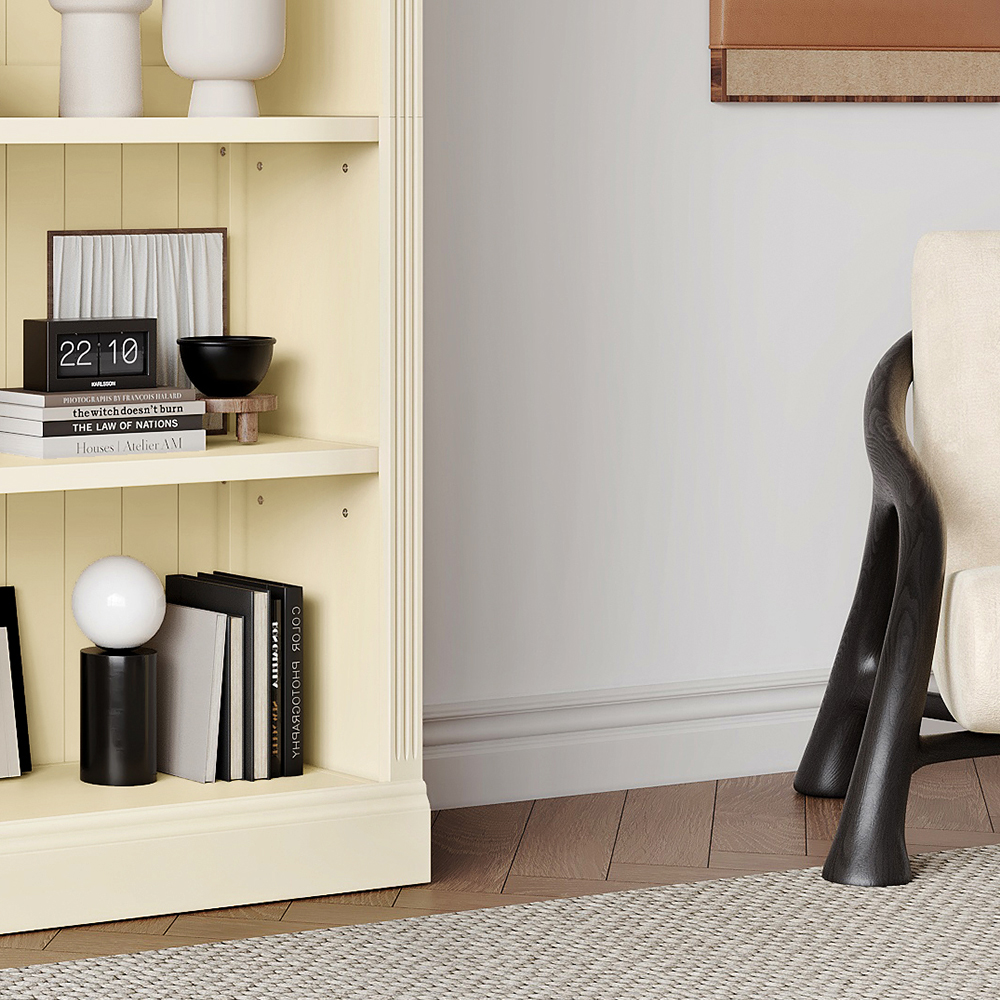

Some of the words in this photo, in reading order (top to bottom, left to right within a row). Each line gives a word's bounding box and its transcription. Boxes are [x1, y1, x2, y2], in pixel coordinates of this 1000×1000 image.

[59, 340, 93, 367] 22
[108, 337, 138, 365] 10
[63, 395, 113, 404] PHOTOGRAPHS
[122, 393, 155, 402] FRANÇOIS
[155, 392, 182, 400] HALARD
[73, 407, 90, 418] the
[90, 407, 119, 417] witch
[121, 404, 158, 415] doesn't
[160, 404, 183, 413] burn
[72, 422, 93, 432] THE
[96, 422, 117, 431] LAW
[119, 421, 133, 430] OF
[135, 419, 179, 429] NATIONS
[76, 441, 115, 454] Houses
[123, 439, 160, 452] Atelier
[161, 437, 182, 450] AM
